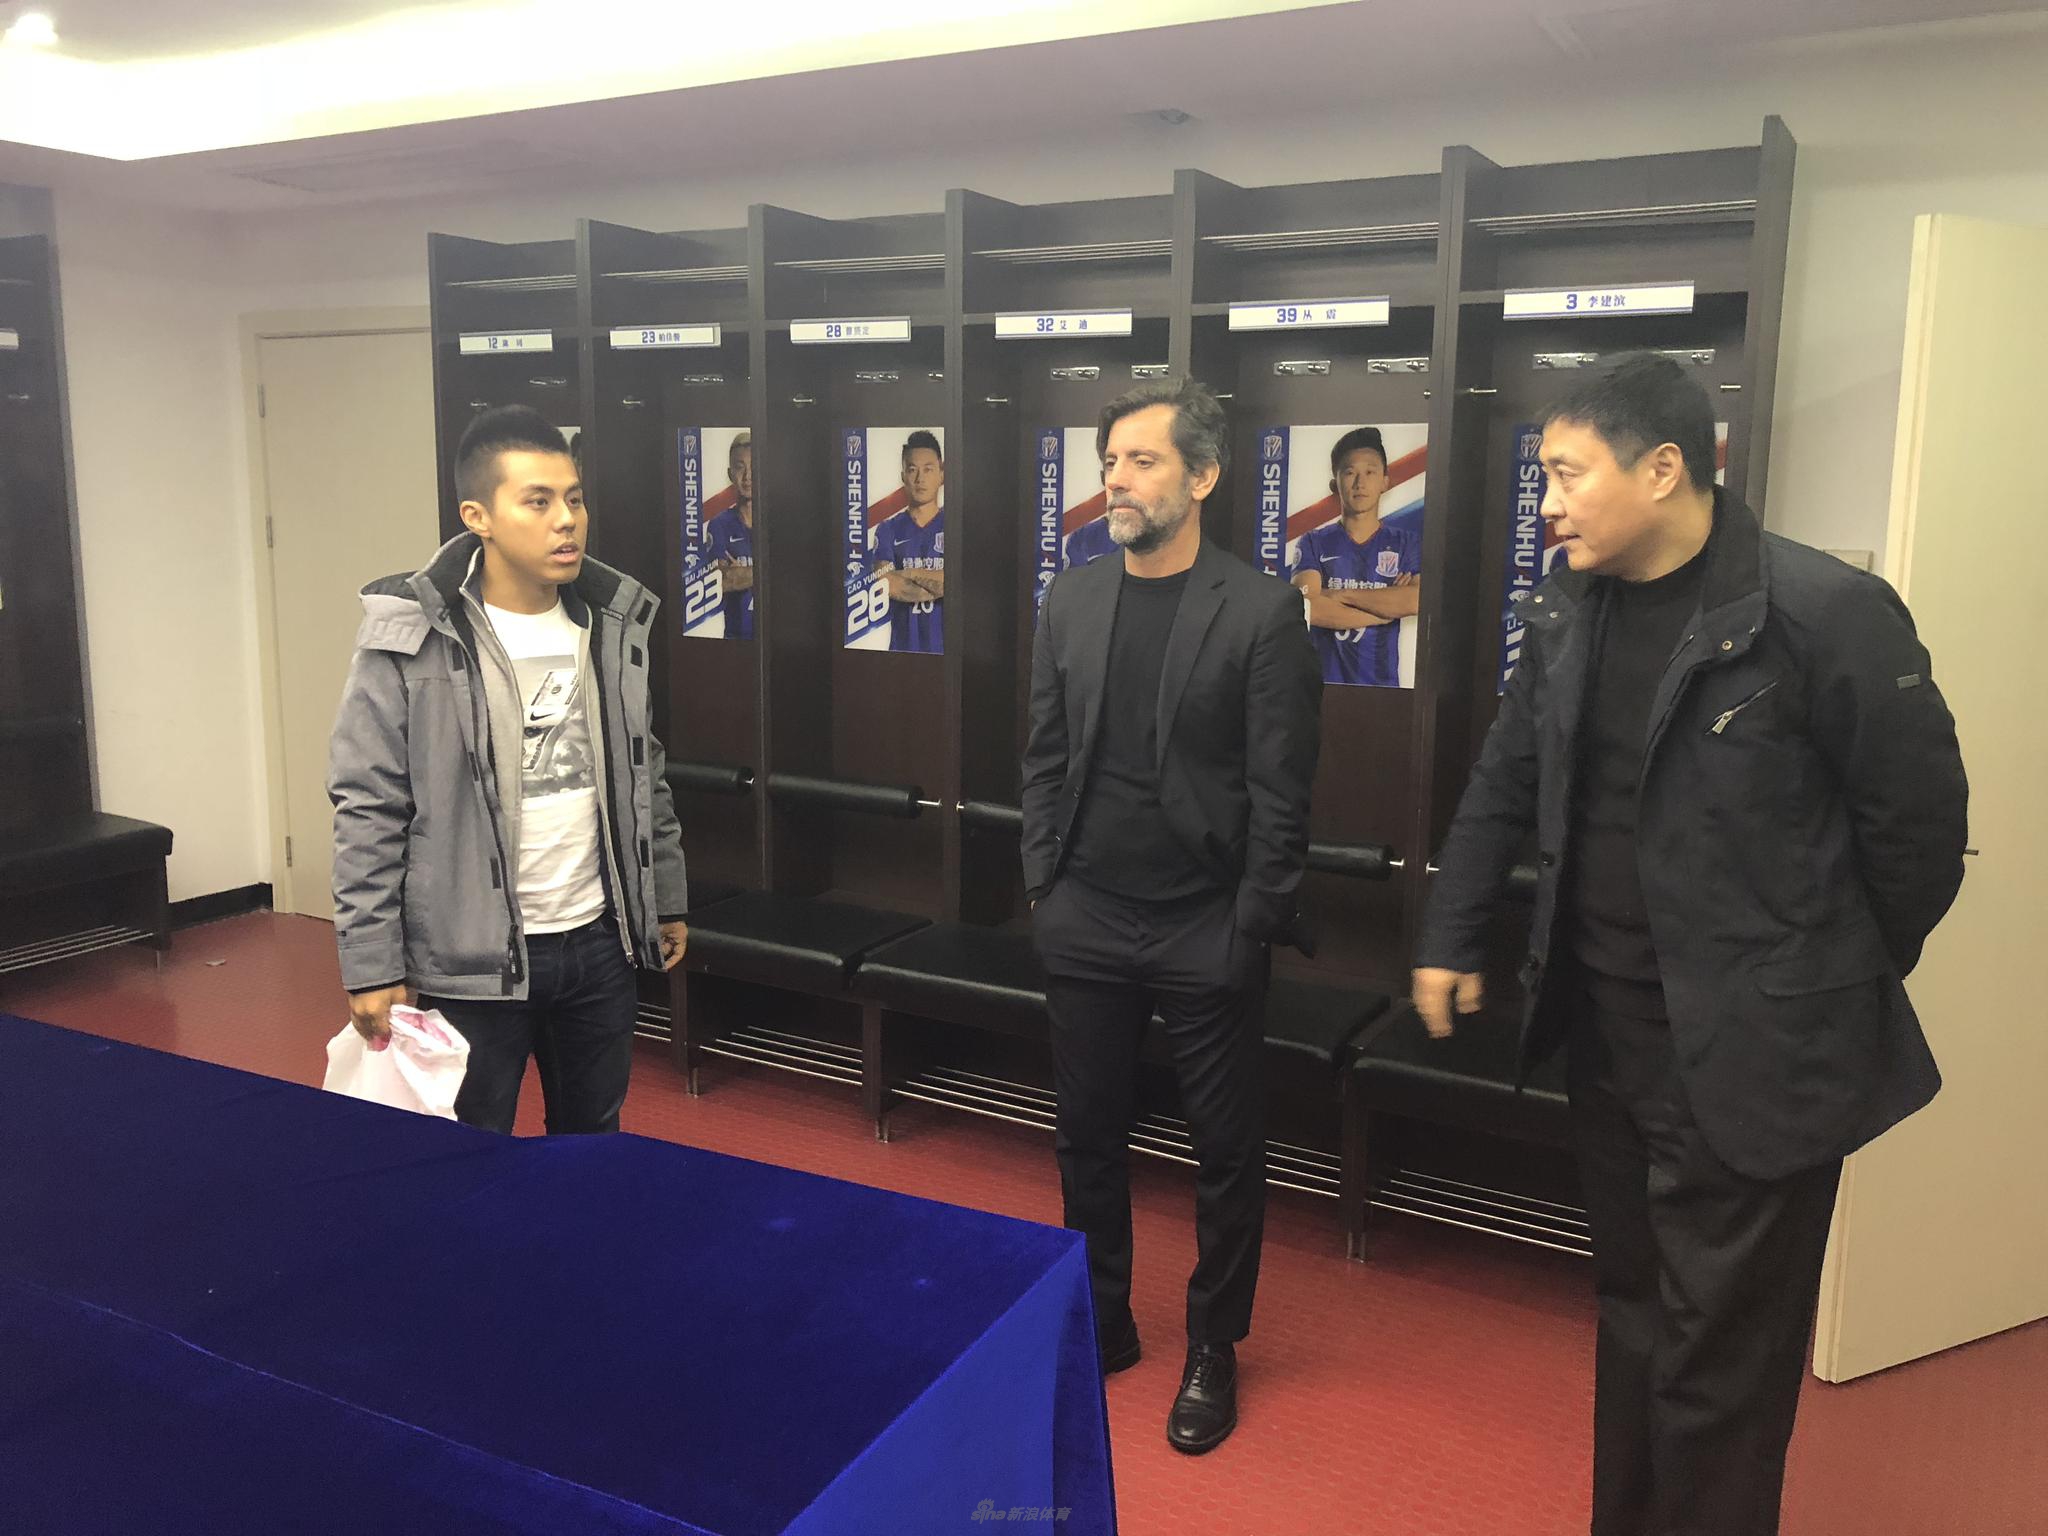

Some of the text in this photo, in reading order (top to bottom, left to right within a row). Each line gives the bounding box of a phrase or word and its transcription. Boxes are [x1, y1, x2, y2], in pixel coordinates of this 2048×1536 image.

[1566, 293, 1578, 310] 3
[1276, 307, 1297, 323] 39
[826, 324, 841, 338] 28
[1036, 317, 1054, 332] 32
[488, 337, 498, 349] 12
[641, 331, 656, 344] 23
[847, 561, 896, 595] CAO YUNDING
[685, 568, 723, 625] 23
[847, 576, 890, 636] 28
